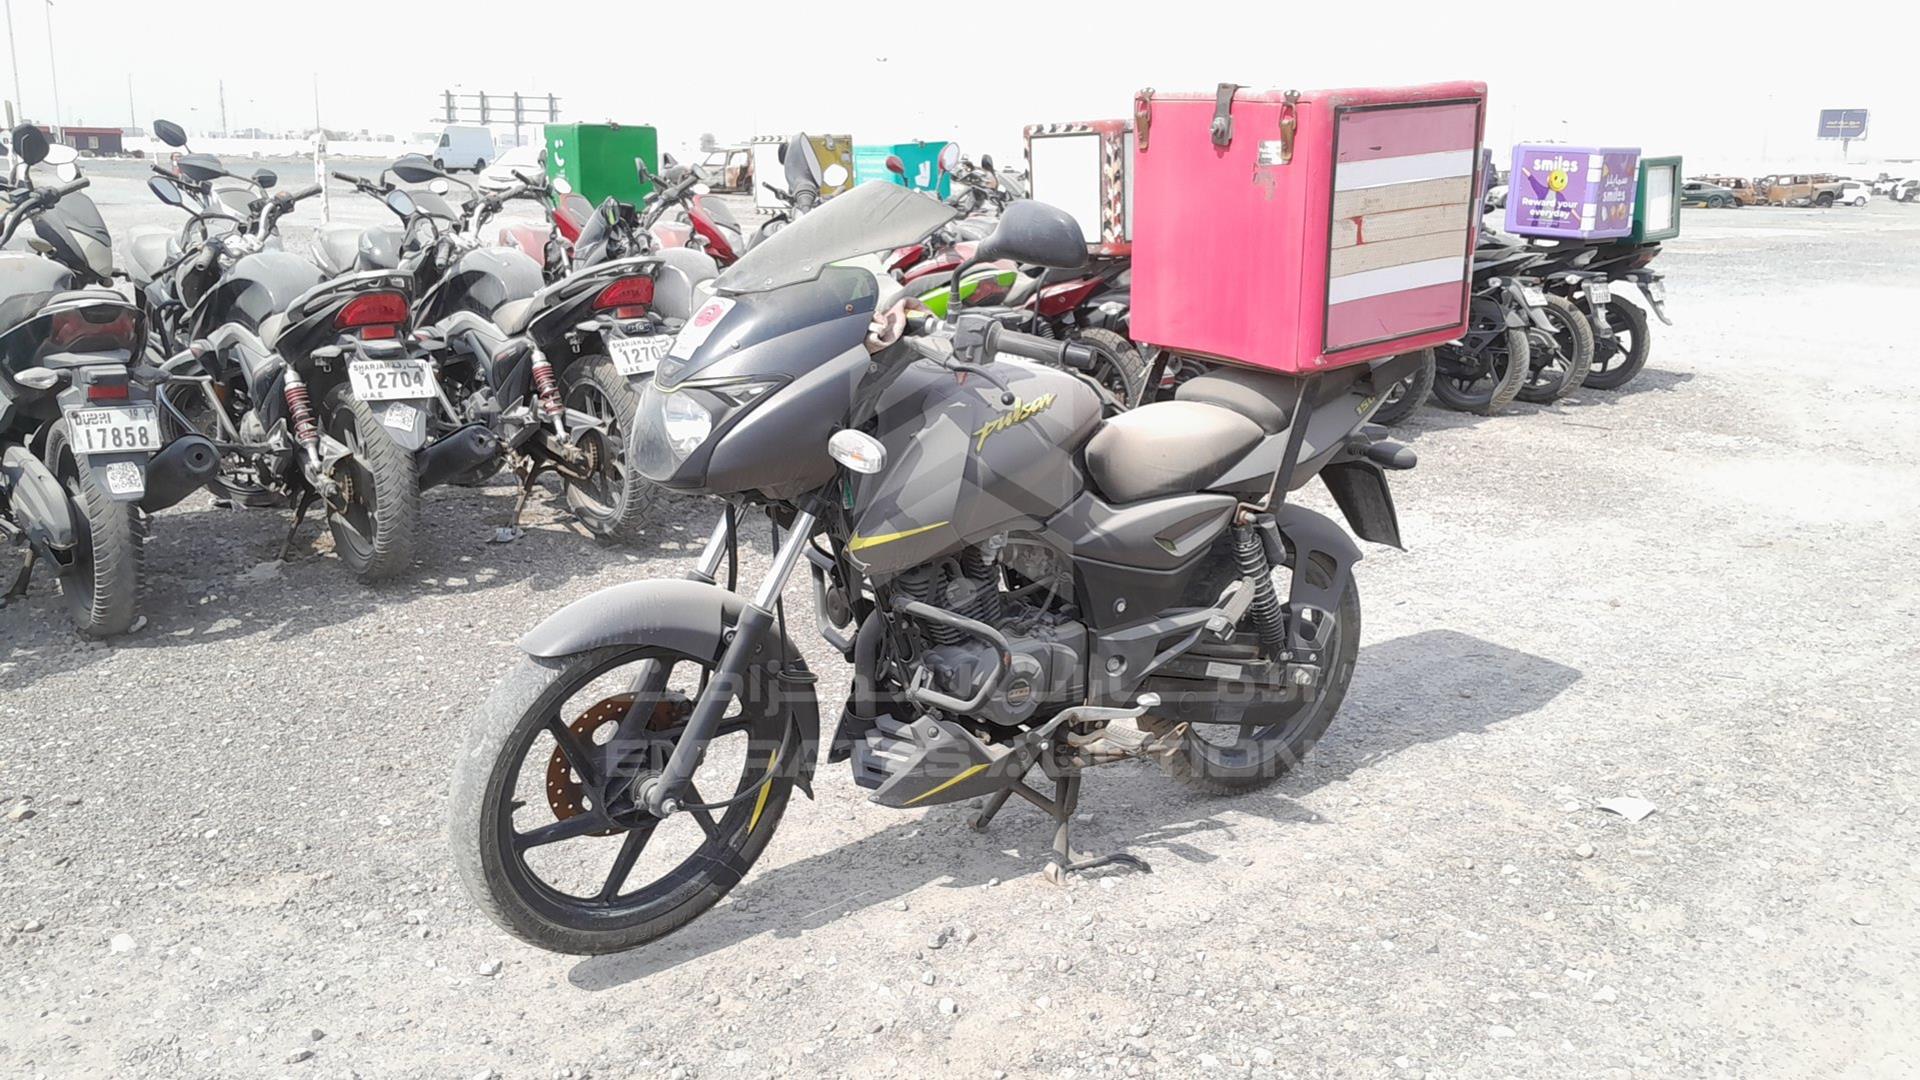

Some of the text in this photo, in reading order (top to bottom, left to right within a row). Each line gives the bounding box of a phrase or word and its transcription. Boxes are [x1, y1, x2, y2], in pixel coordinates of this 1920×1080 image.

[1533, 156, 1579, 173] smiles
[1602, 187, 1626, 203] smiles
[1522, 197, 1579, 210] Reward your
[1529, 208, 1571, 220] everyday
[353, 362, 391, 372] SHARJAH
[364, 371, 424, 390] 12704
[85, 426, 150, 450] 17858
